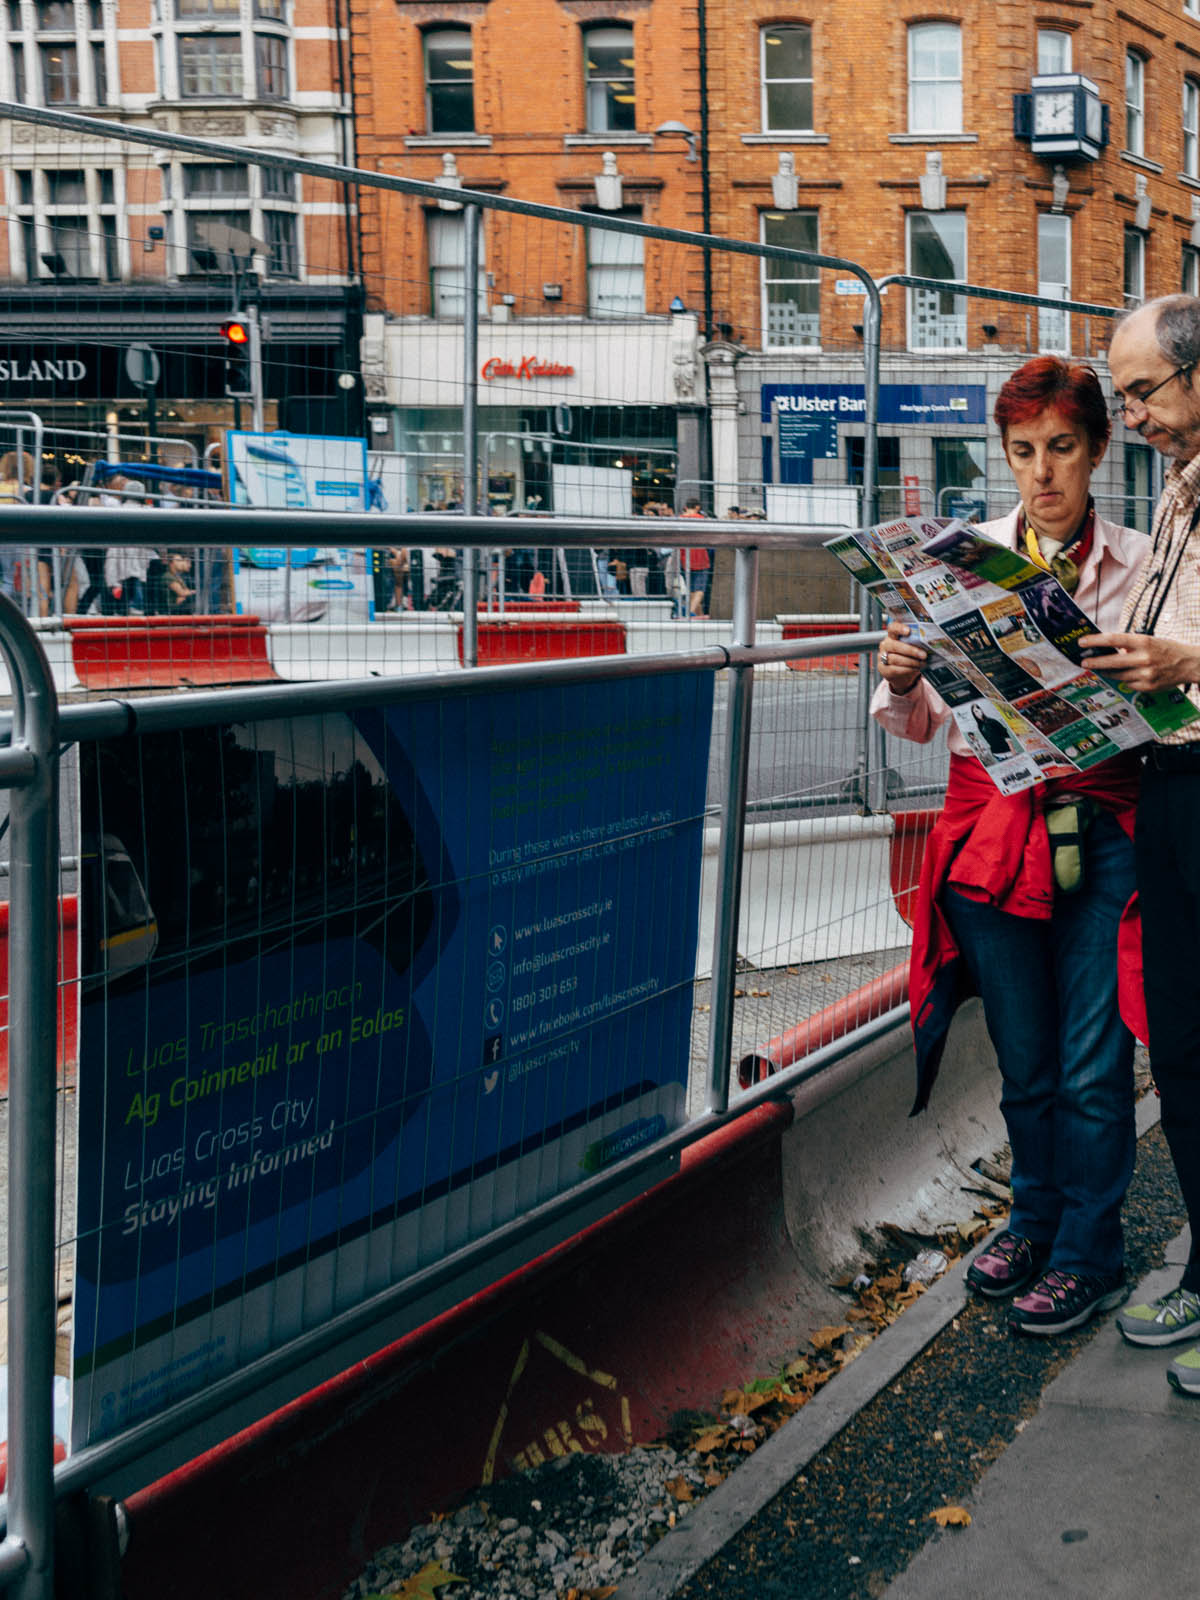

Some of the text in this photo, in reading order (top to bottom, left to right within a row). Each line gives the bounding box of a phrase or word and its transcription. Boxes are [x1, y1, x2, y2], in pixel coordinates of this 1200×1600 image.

[790, 396, 867, 412] Ulster Ban
[514, 899, 613, 941] www.luascrosscity.ie
[513, 932, 611, 976] info@luascrosscity.ie
[512, 976, 578, 1013] 1800 303 653
[125, 1092, 161, 1127] Ag
[285, 1041, 311, 1065] ar
[316, 1029, 342, 1055] an
[351, 1007, 405, 1042] Eolas
[127, 1037, 188, 1077] Luas
[124, 1096, 314, 1190] Luas Cross City
[122, 1119, 335, 1235] Staying informed
